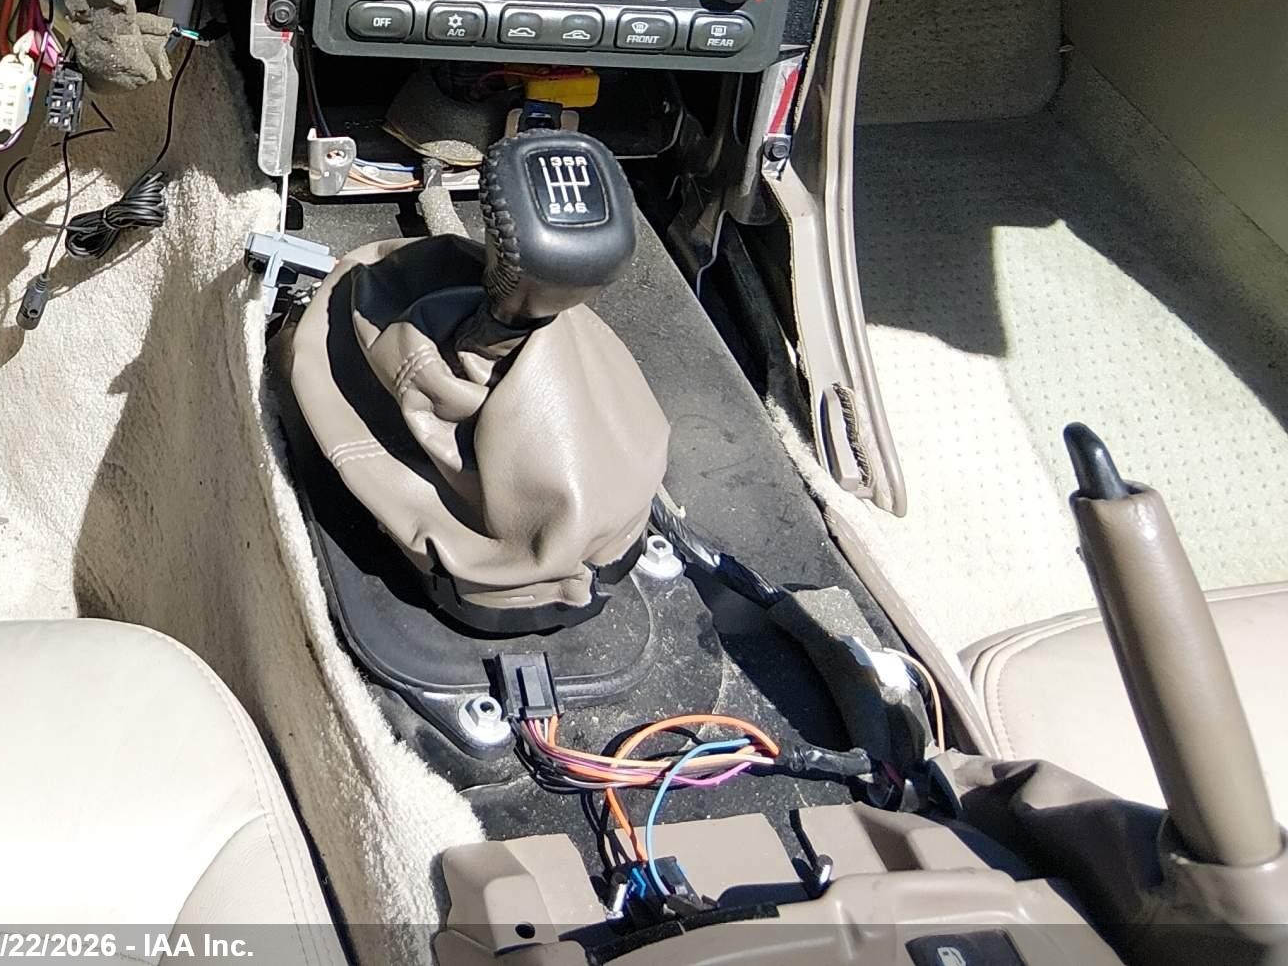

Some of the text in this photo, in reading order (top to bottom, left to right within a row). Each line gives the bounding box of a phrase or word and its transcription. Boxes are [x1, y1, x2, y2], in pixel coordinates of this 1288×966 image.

[373, 16, 391, 28] OFF
[447, 27, 465, 38] A/C
[626, 33, 660, 45] FRONT
[707, 37, 733, 48] REAR
[550, 156, 562, 166] 3
[563, 156, 574, 166] 5
[575, 156, 587, 166] R
[549, 203, 560, 214] 2
[563, 203, 574, 213] 4
